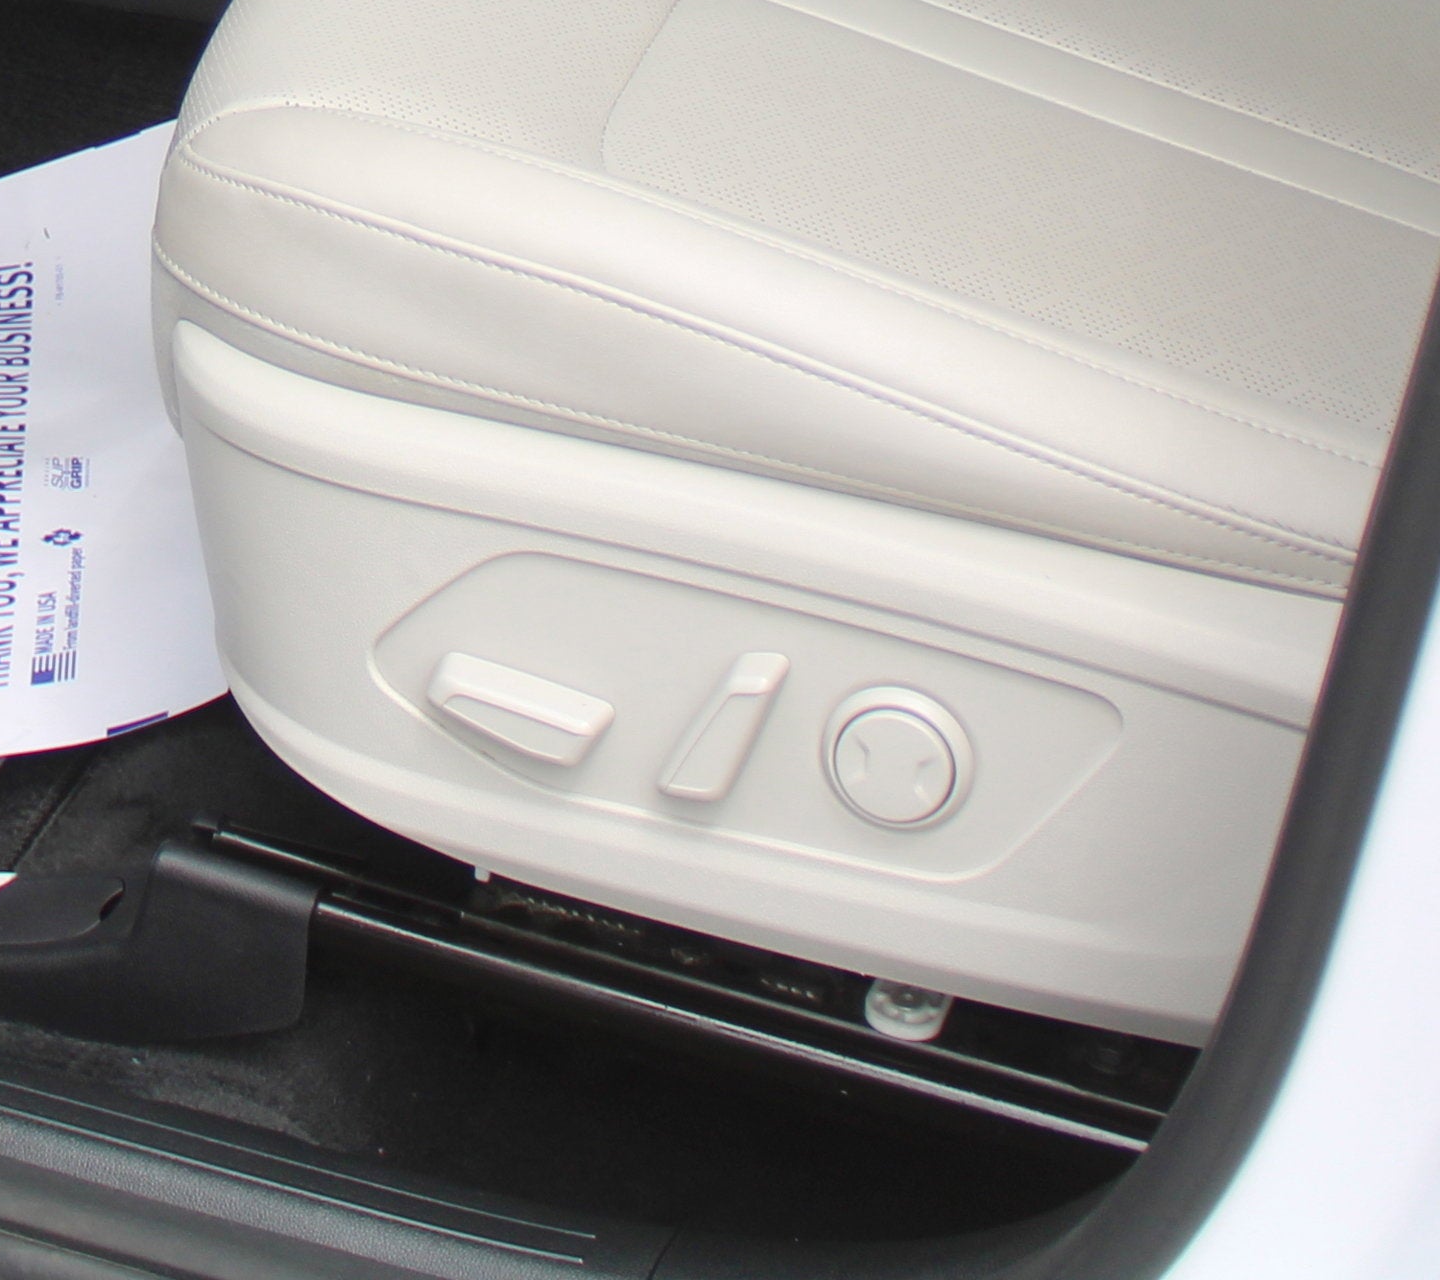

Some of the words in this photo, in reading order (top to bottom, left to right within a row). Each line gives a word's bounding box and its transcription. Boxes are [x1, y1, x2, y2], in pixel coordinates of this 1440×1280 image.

[38, 591, 57, 613] USA
[36, 614, 55, 625] IN
[34, 627, 55, 655] MADE
